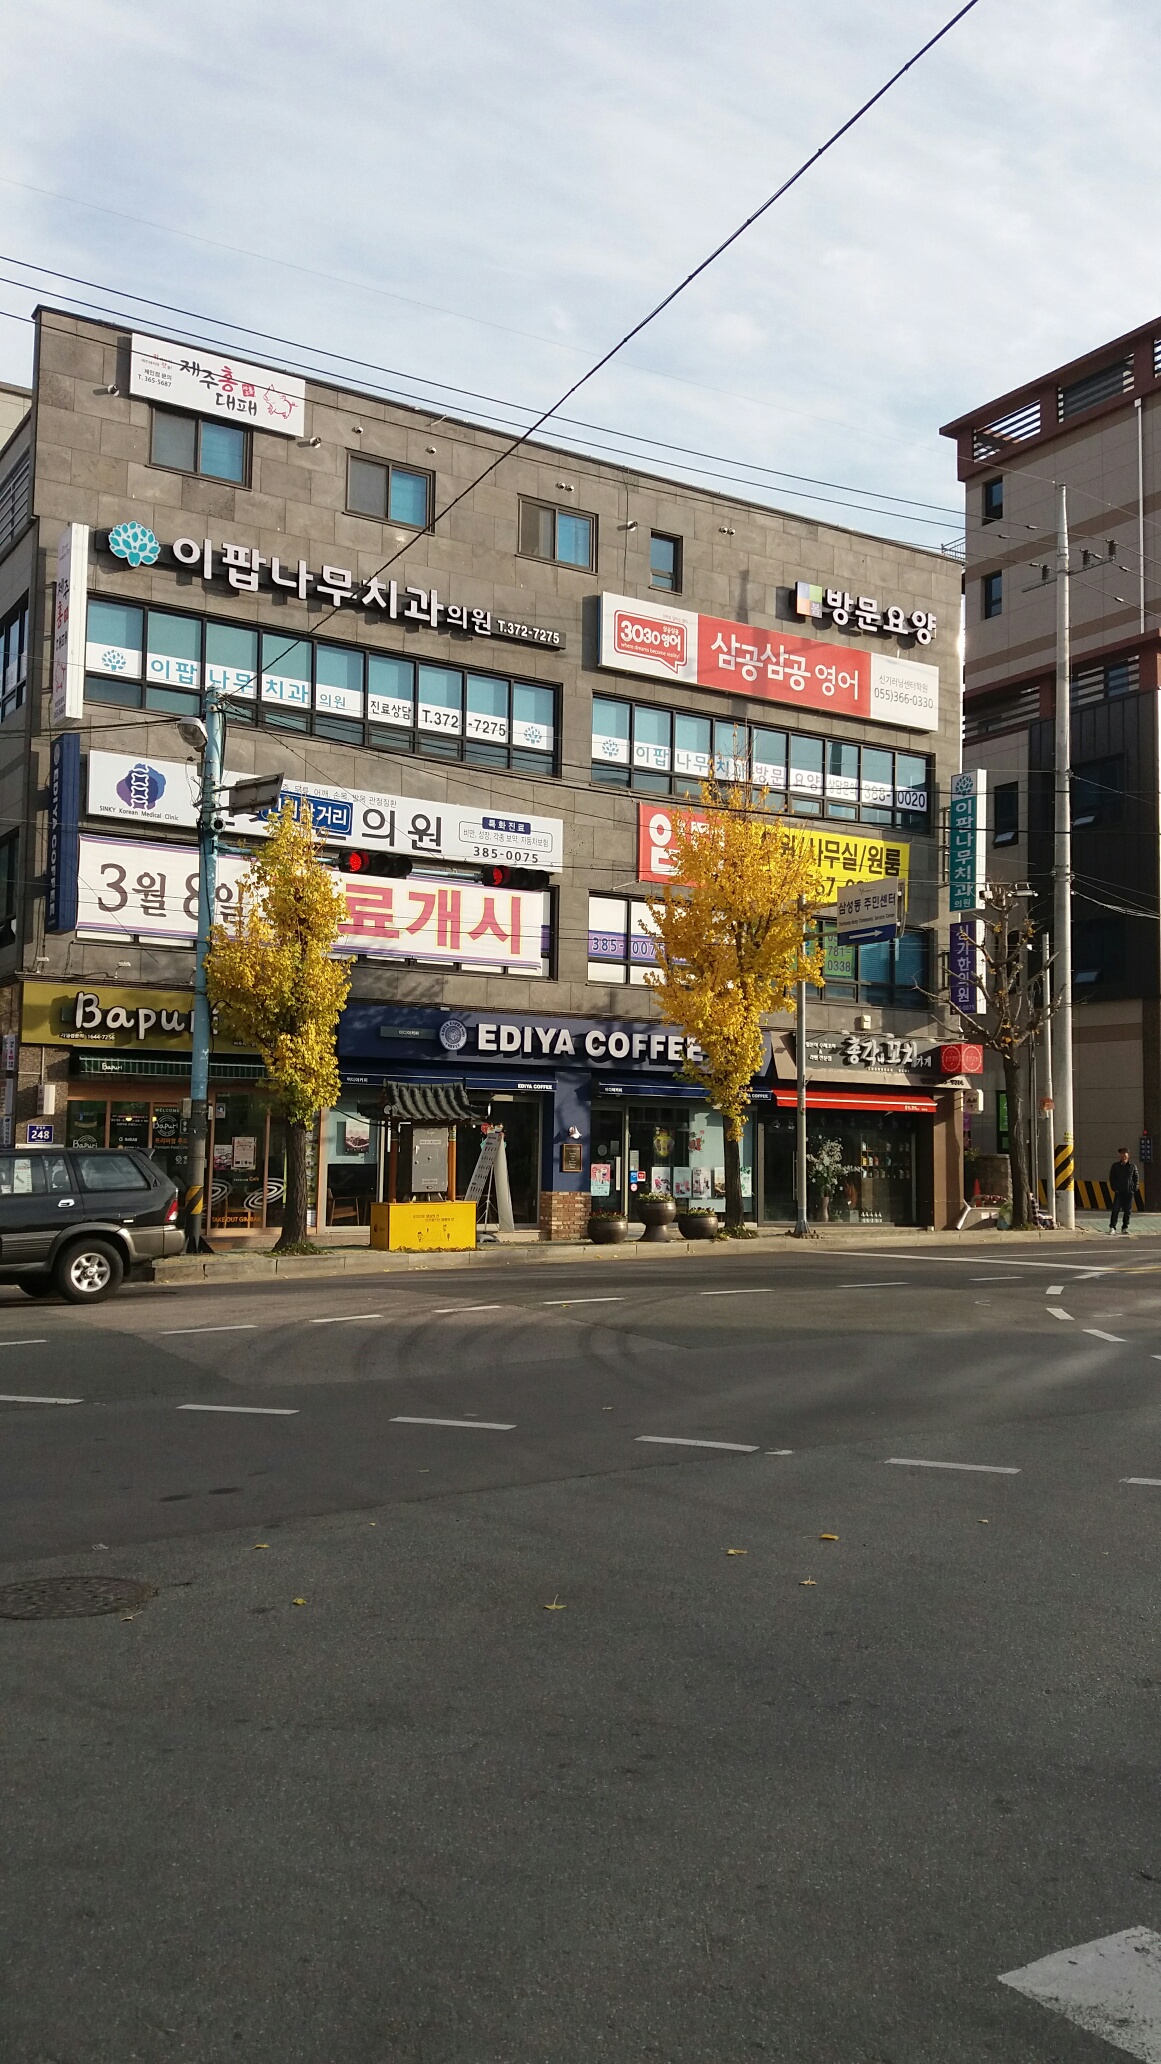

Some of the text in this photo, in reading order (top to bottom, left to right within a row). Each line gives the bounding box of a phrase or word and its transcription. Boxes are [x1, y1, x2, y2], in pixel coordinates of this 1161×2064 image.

[447, 603, 492, 635] 의원
[497, 619, 560, 644] T.372-7275
[825, 588, 937, 645] 방문요양
[620, 620, 681, 652] 3030 영어
[710, 631, 860, 701] 삼공삼공 영어
[319, 692, 347, 710] 의원
[369, 699, 413, 722] 진료상담
[873, 687, 935, 709] 055)366-0330
[118, 807, 139, 816] Korean
[140, 810, 163, 820] Medical
[164, 813, 180, 822] Clinic
[473, 846, 539, 864] 385-0075
[97, 862, 168, 918] 3월
[838, 892, 896, 916] 삼성동 주민센터
[954, 898, 971, 909] 의원
[827, 959, 851, 973] 0338
[476, 1022, 705, 1063] EDIYA COFFEE
[517, 1083, 553, 1091] EDIYA COFFEE
[31, 1129, 50, 1140] 248
